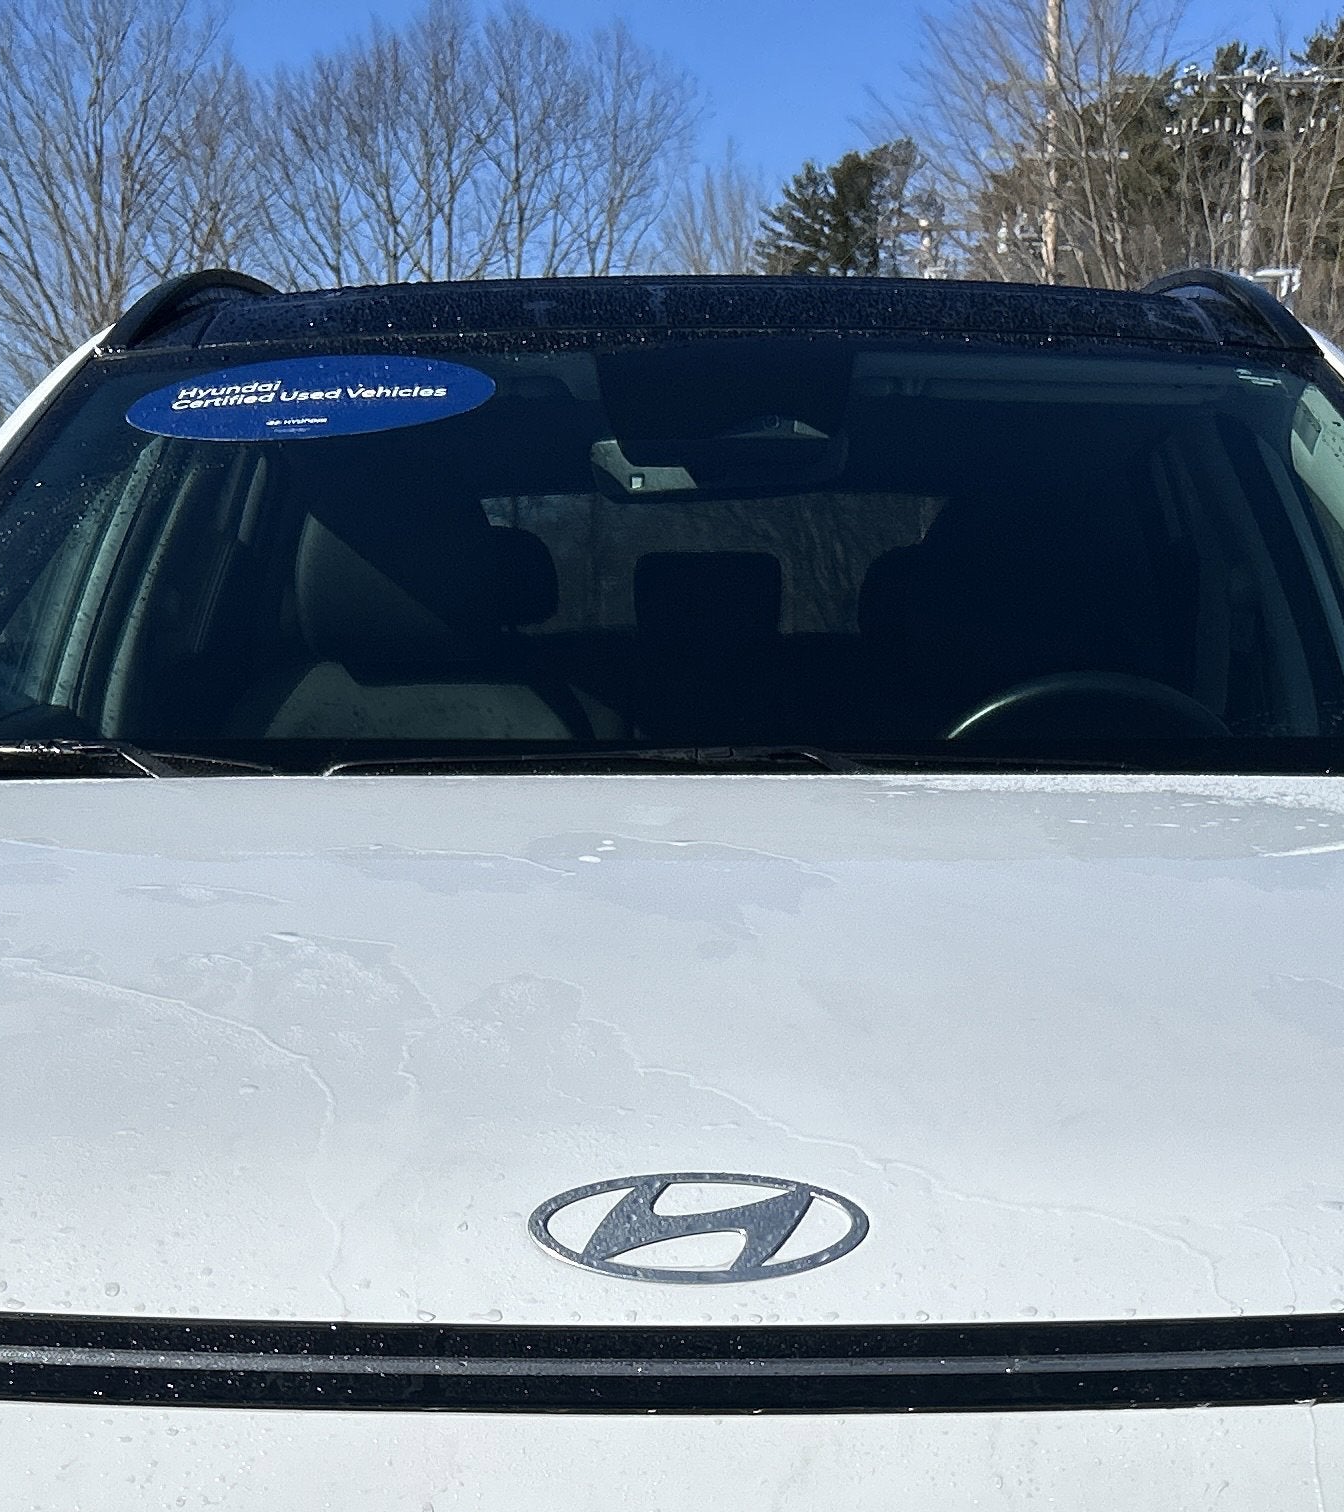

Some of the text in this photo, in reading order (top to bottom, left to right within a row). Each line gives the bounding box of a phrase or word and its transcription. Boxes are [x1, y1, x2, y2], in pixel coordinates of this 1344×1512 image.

[171, 384, 448, 410] Certified Used Vehicles
[177, 380, 282, 400] Hyundai
